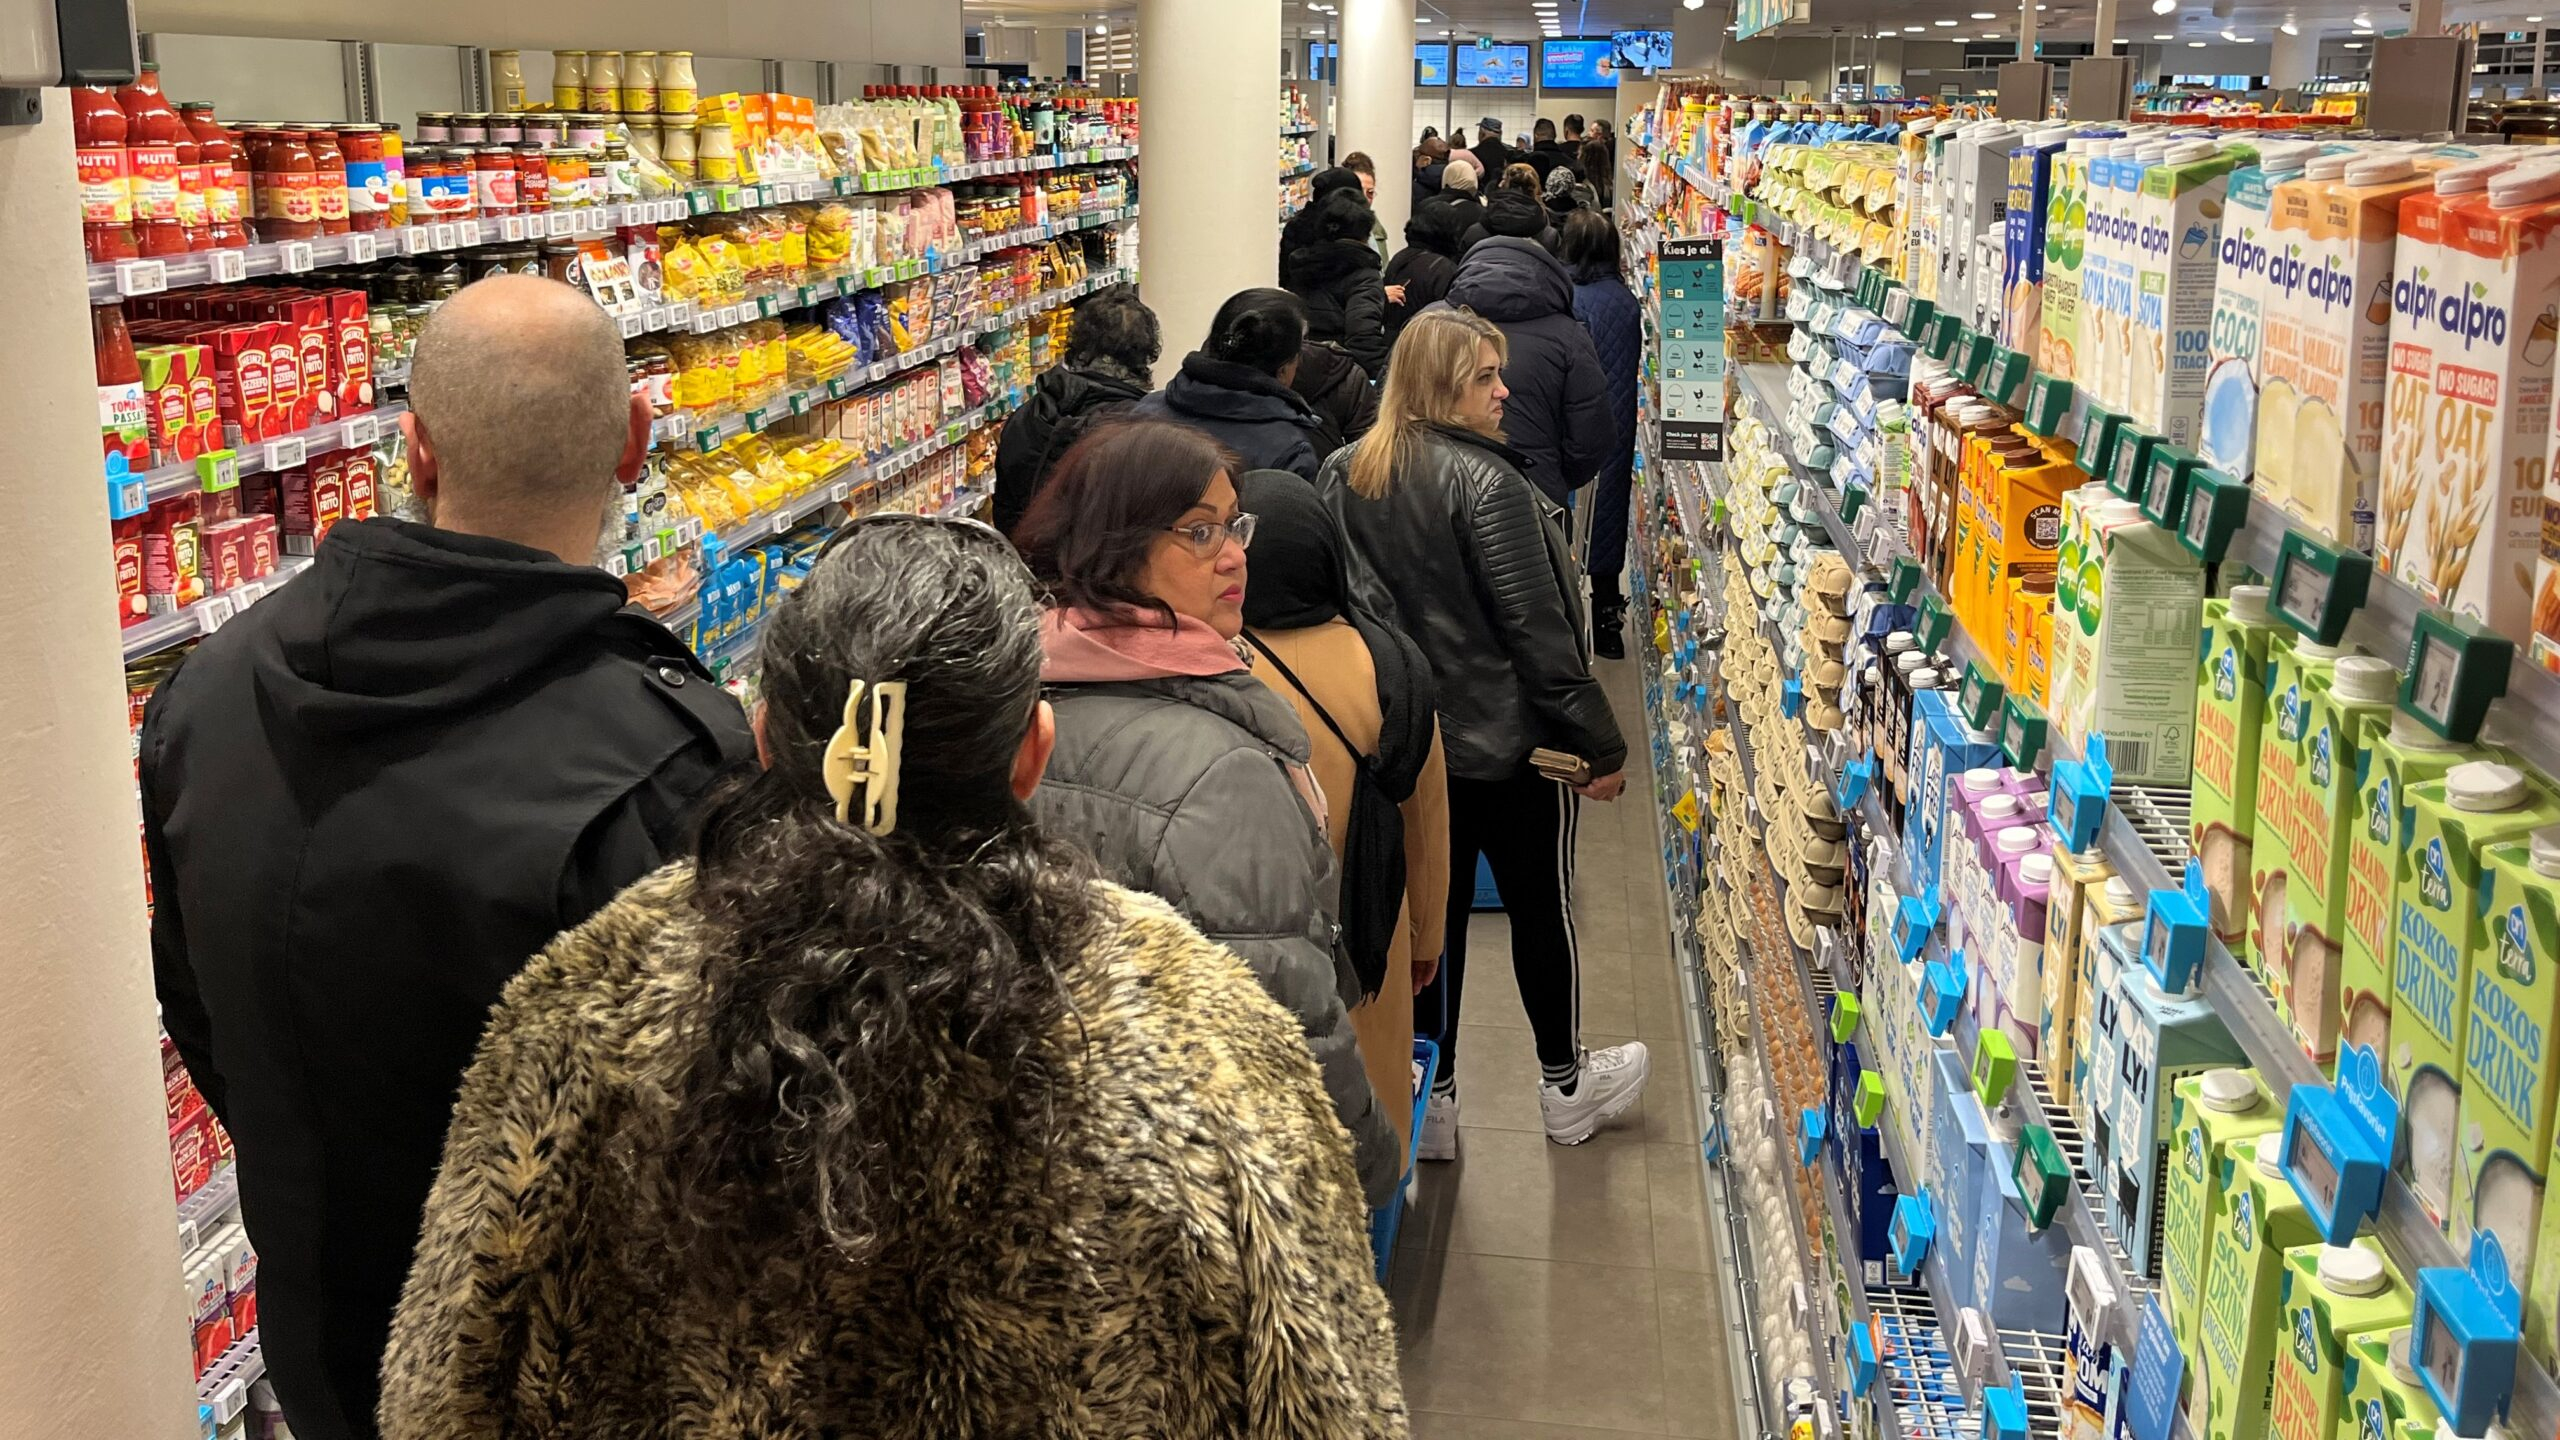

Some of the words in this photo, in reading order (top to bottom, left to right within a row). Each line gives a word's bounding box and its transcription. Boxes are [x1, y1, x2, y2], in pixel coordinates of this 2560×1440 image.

[181, 170, 200, 181] MUT
[214, 168, 232, 178] MUT
[2087, 202, 2110, 242] alpro
[2112, 208, 2137, 250] alpro
[2141, 215, 2169, 260] alpro
[1664, 244, 1685, 255] Kies
[1687, 245, 1697, 256] je
[1700, 245, 1712, 254] ei.
[2222, 227, 2266, 279] alpro
[2269, 244, 2306, 299] alpr
[2308, 254, 2352, 314] alpro
[2395, 266, 2437, 330] alpr
[2175, 331, 2208, 353] 100
[2213, 307, 2257, 361] COCO
[2439, 281, 2506, 351] alpro
[305, 360, 322, 373] FRITO
[347, 352, 364, 366] FRITO
[2438, 369, 2455, 391] NO
[2457, 372, 2497, 401] SUGARS
[112, 398, 144, 413] TOMA
[2435, 396, 2493, 463] OAT
[320, 497, 338, 512] FRITO
[352, 485, 370, 500] FRITO
[2030, 506, 2050, 520] SCAN
[120, 567, 137, 579] FRITO
[2404, 640, 2417, 679] Vegan
[2194, 728, 2233, 799] DRINK
[2290, 815, 2327, 899] DRINK
[2421, 864, 2449, 908] terra
[2346, 871, 2387, 967] DRINK
[2402, 900, 2458, 982] KOKOS
[2098, 951, 2121, 1004] OA
[2500, 935, 2532, 981] terra
[2396, 939, 2455, 1044] DRINK
[2474, 968, 2541, 1065] KOKOS
[2119, 999, 2155, 1067] OAT
[2122, 1041, 2147, 1105] LY!
[2467, 1011, 2538, 1130] DRINK
[2341, 1073, 2387, 1142] Prijsfavoriet
[2170, 1165, 2200, 1236] SOJA
[2166, 1190, 2199, 1281] DRINK
[2217, 1230, 2248, 1298] SOJA
[2208, 1257, 2246, 1356] DRINK
[2202, 1306, 2238, 1386] ONGEZOET
[2295, 1322, 2316, 1369] terra
[2277, 1346, 2320, 1438] AMANDEL
